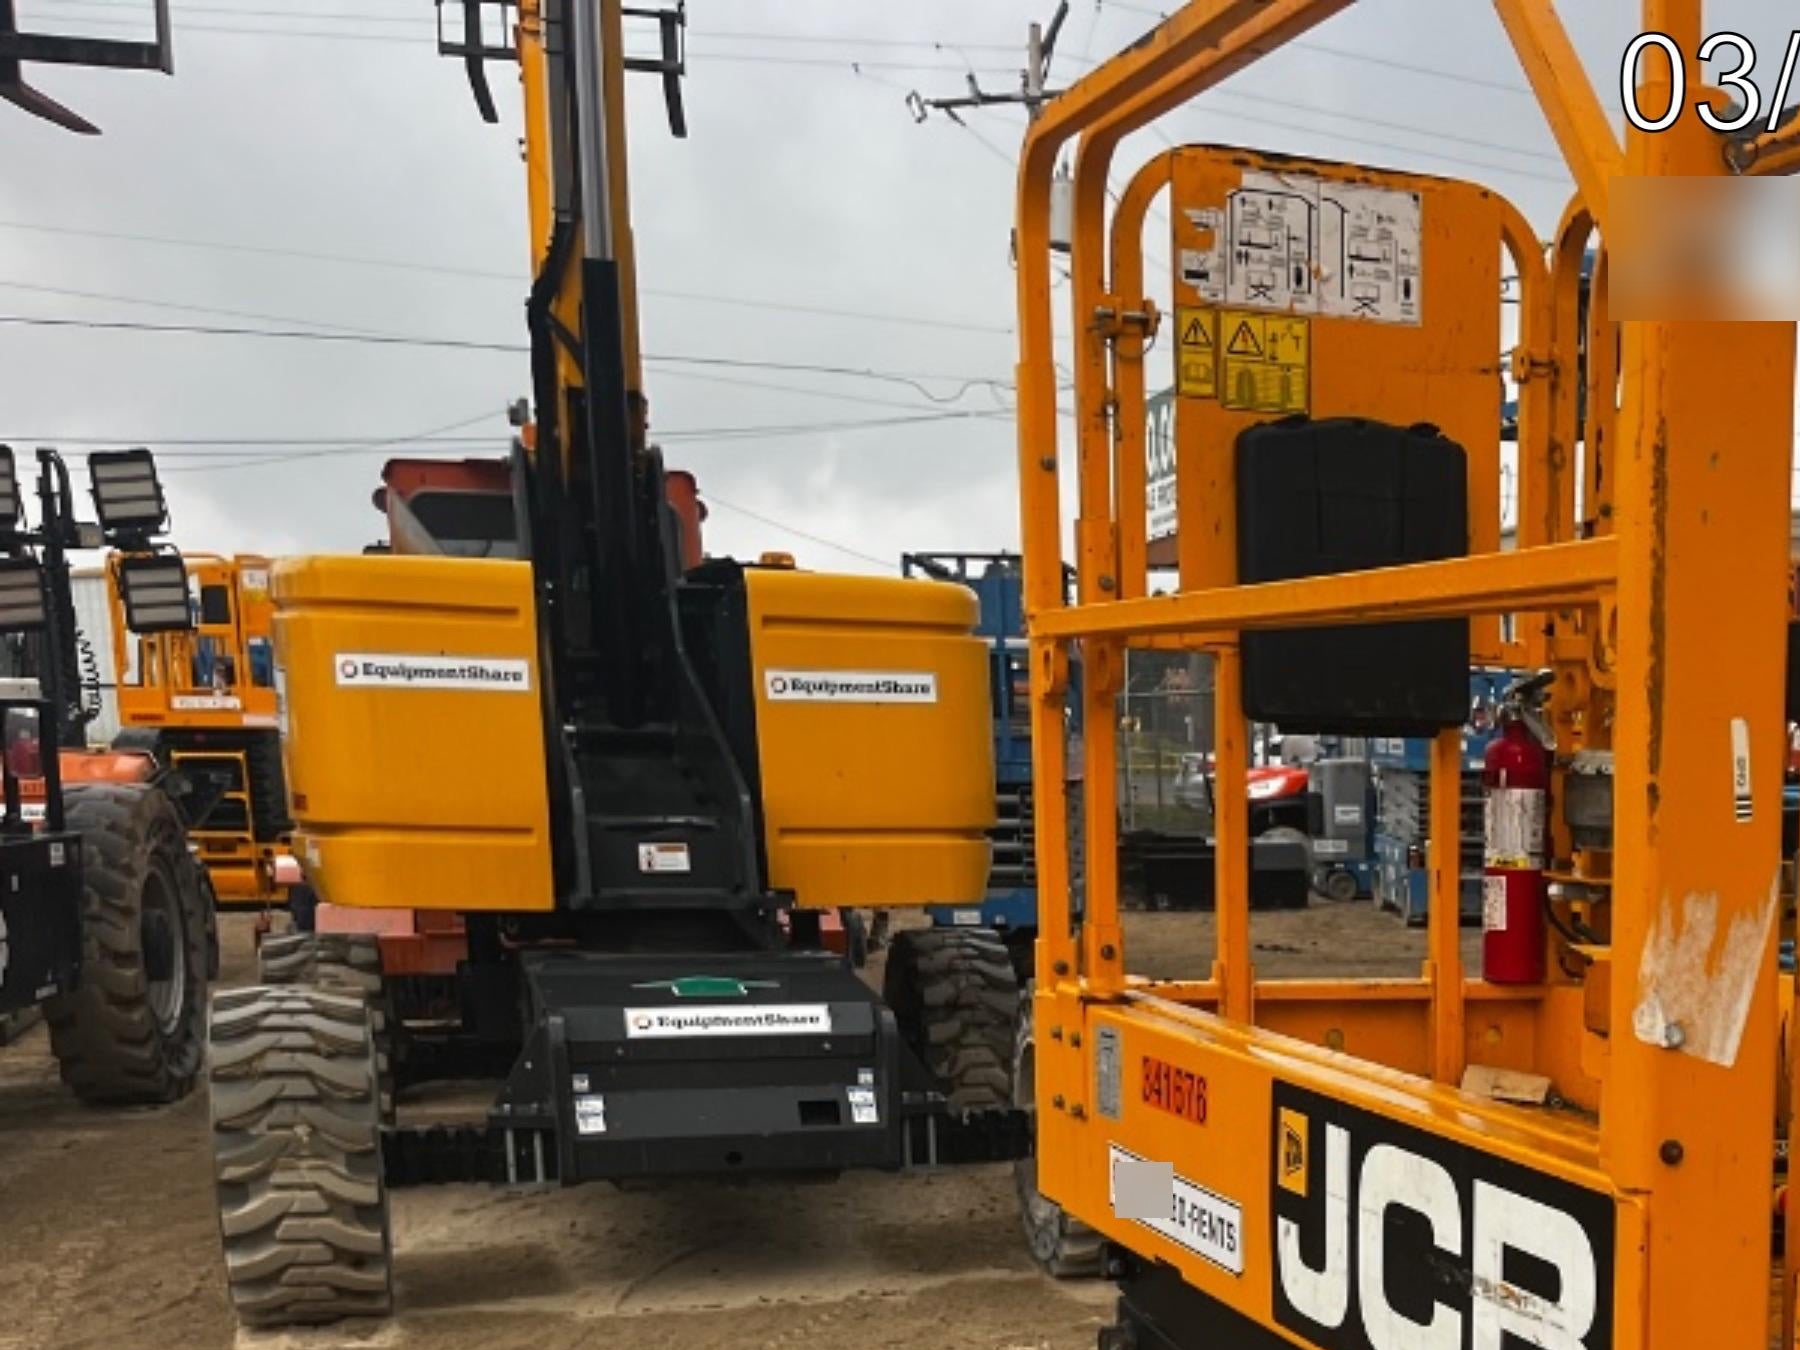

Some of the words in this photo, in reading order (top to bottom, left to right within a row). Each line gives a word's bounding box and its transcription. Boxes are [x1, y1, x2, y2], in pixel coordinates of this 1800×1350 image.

[362, 660, 523, 683] EquipmentShare
[790, 676, 932, 697] EquipmentShare
[656, 1012, 821, 1031] EquipmentShare
